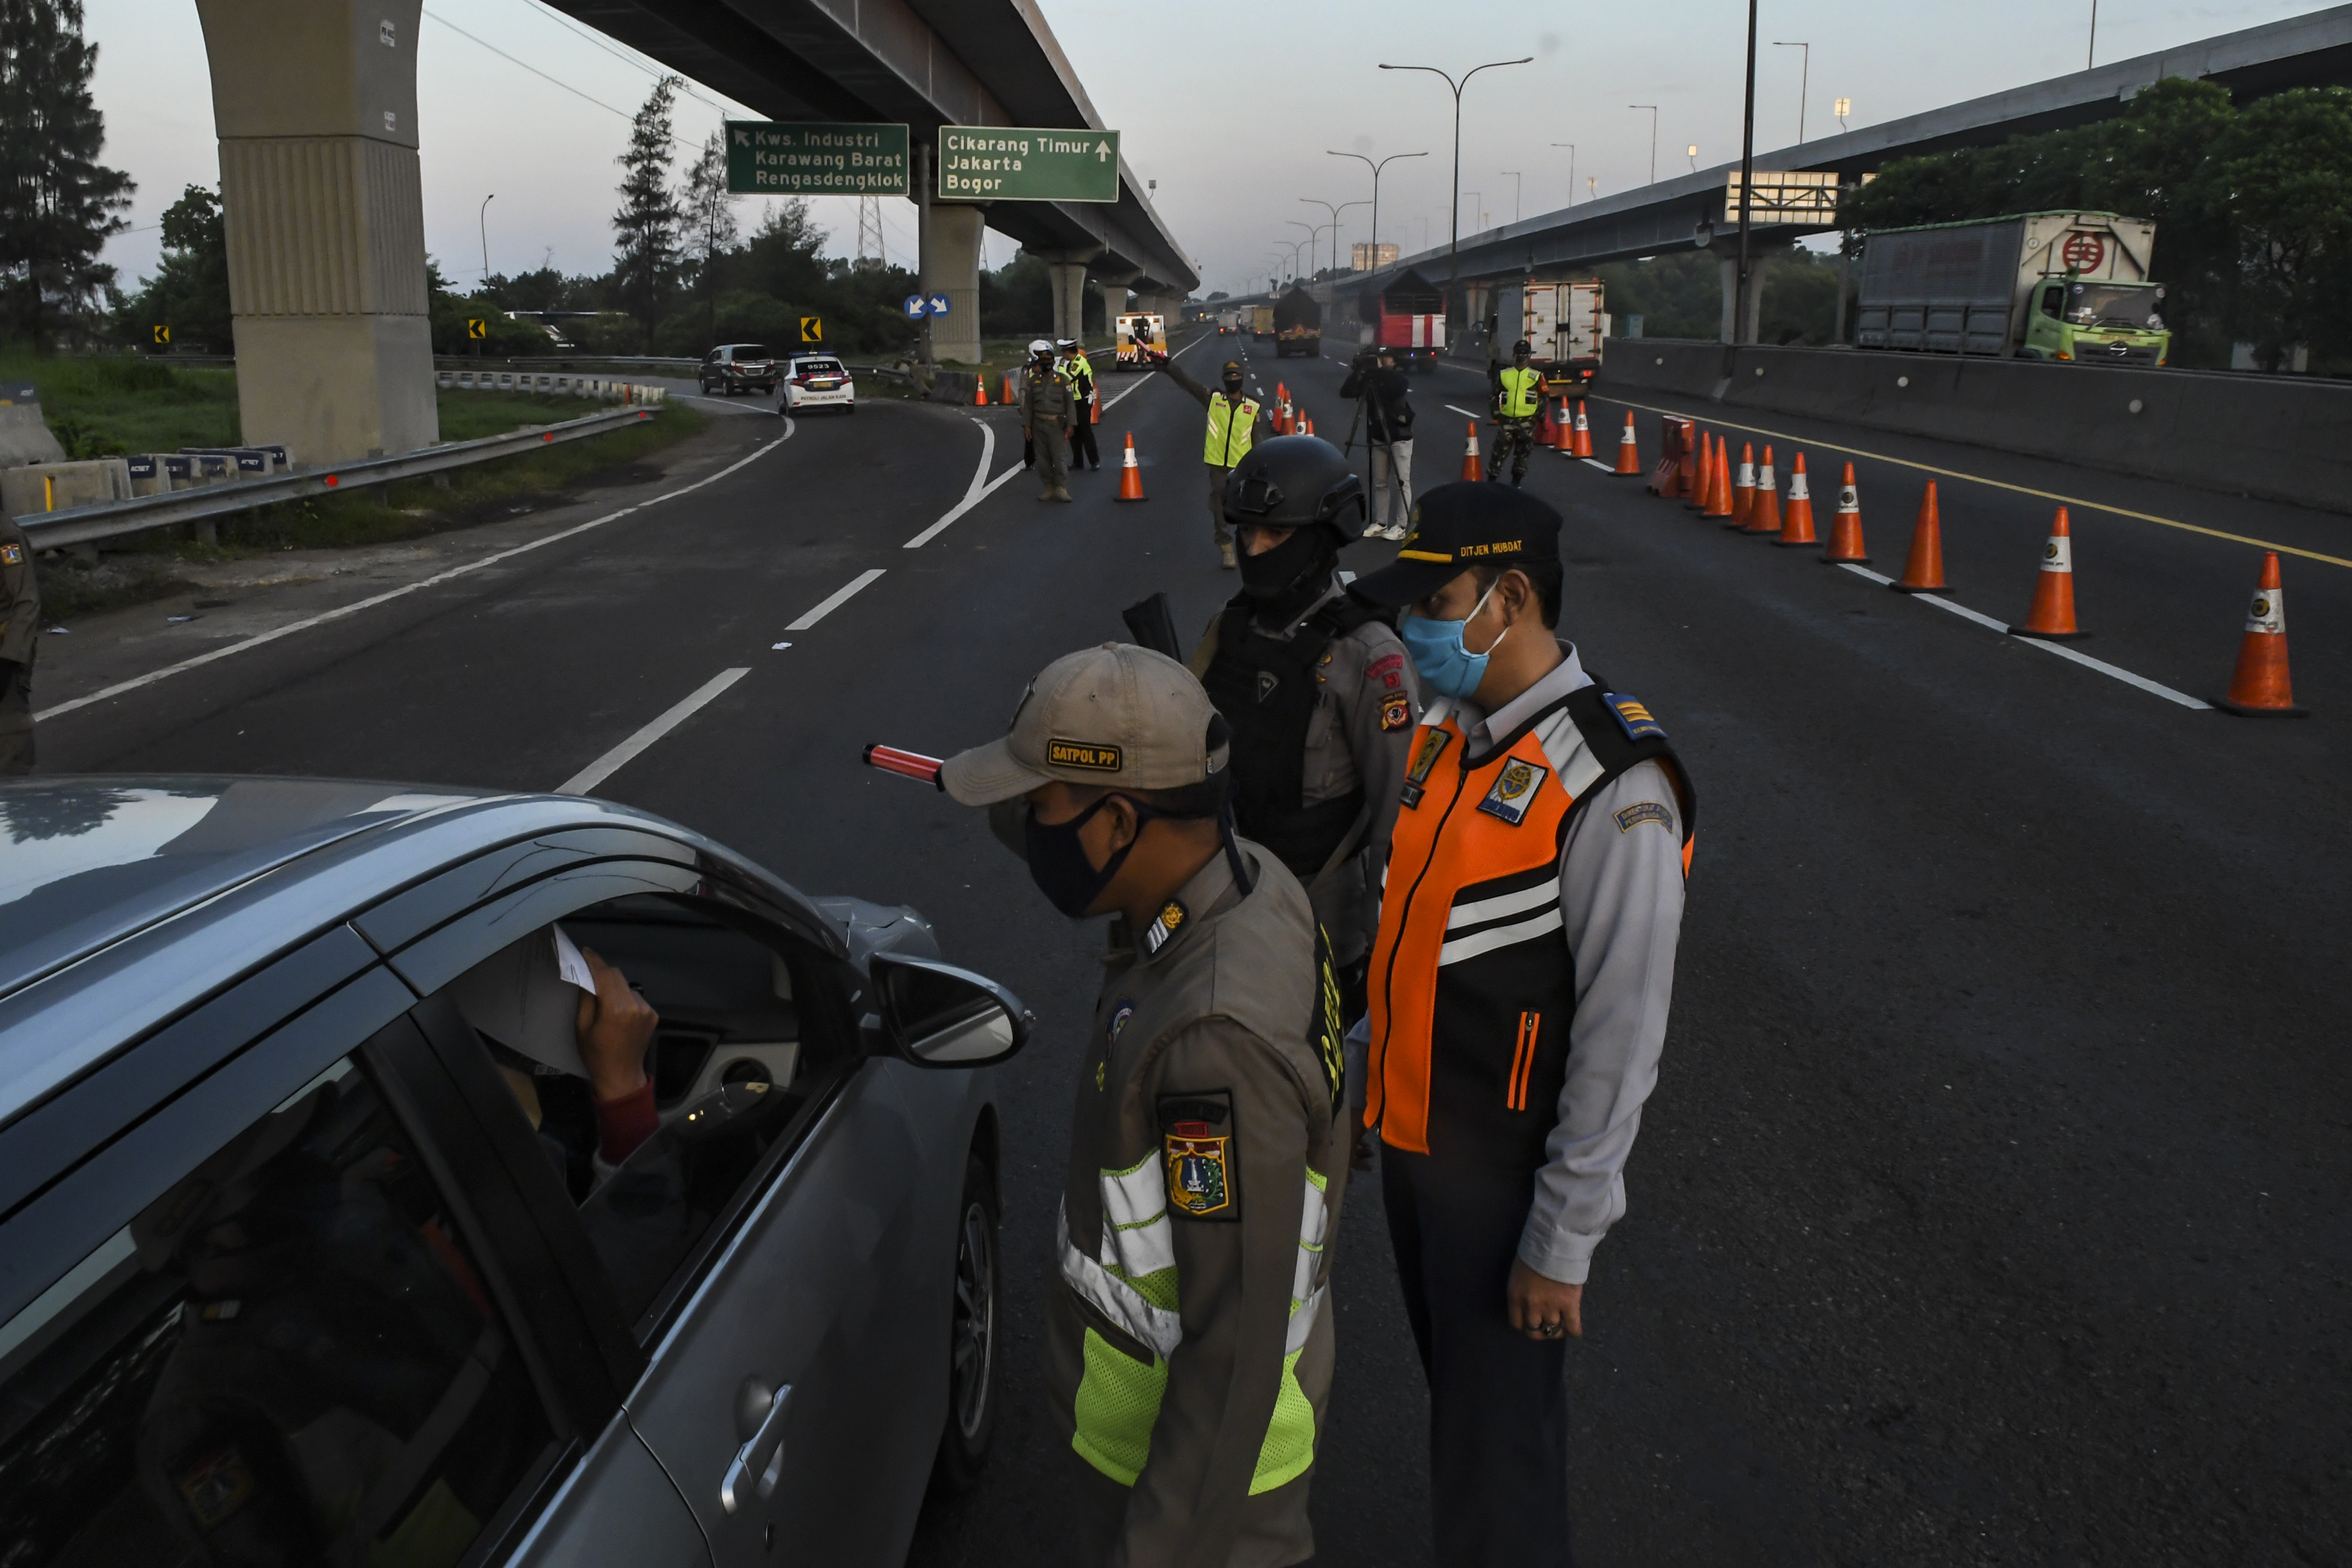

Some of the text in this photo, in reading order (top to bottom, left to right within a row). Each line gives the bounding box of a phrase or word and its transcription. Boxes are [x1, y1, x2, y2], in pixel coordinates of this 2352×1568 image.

[755, 131, 879, 147] Kws. Industri
[947, 135, 1091, 156] Cikarang Timur
[755, 151, 902, 170] Karawang Barat
[947, 155, 1023, 171] Jakarta
[756, 170, 903, 191] Rengasdengklok
[947, 174, 1002, 194] Bogor
[1460, 539, 1522, 557] DITJEN HUBDAT
[1053, 745, 1115, 765] SATPOL PP
